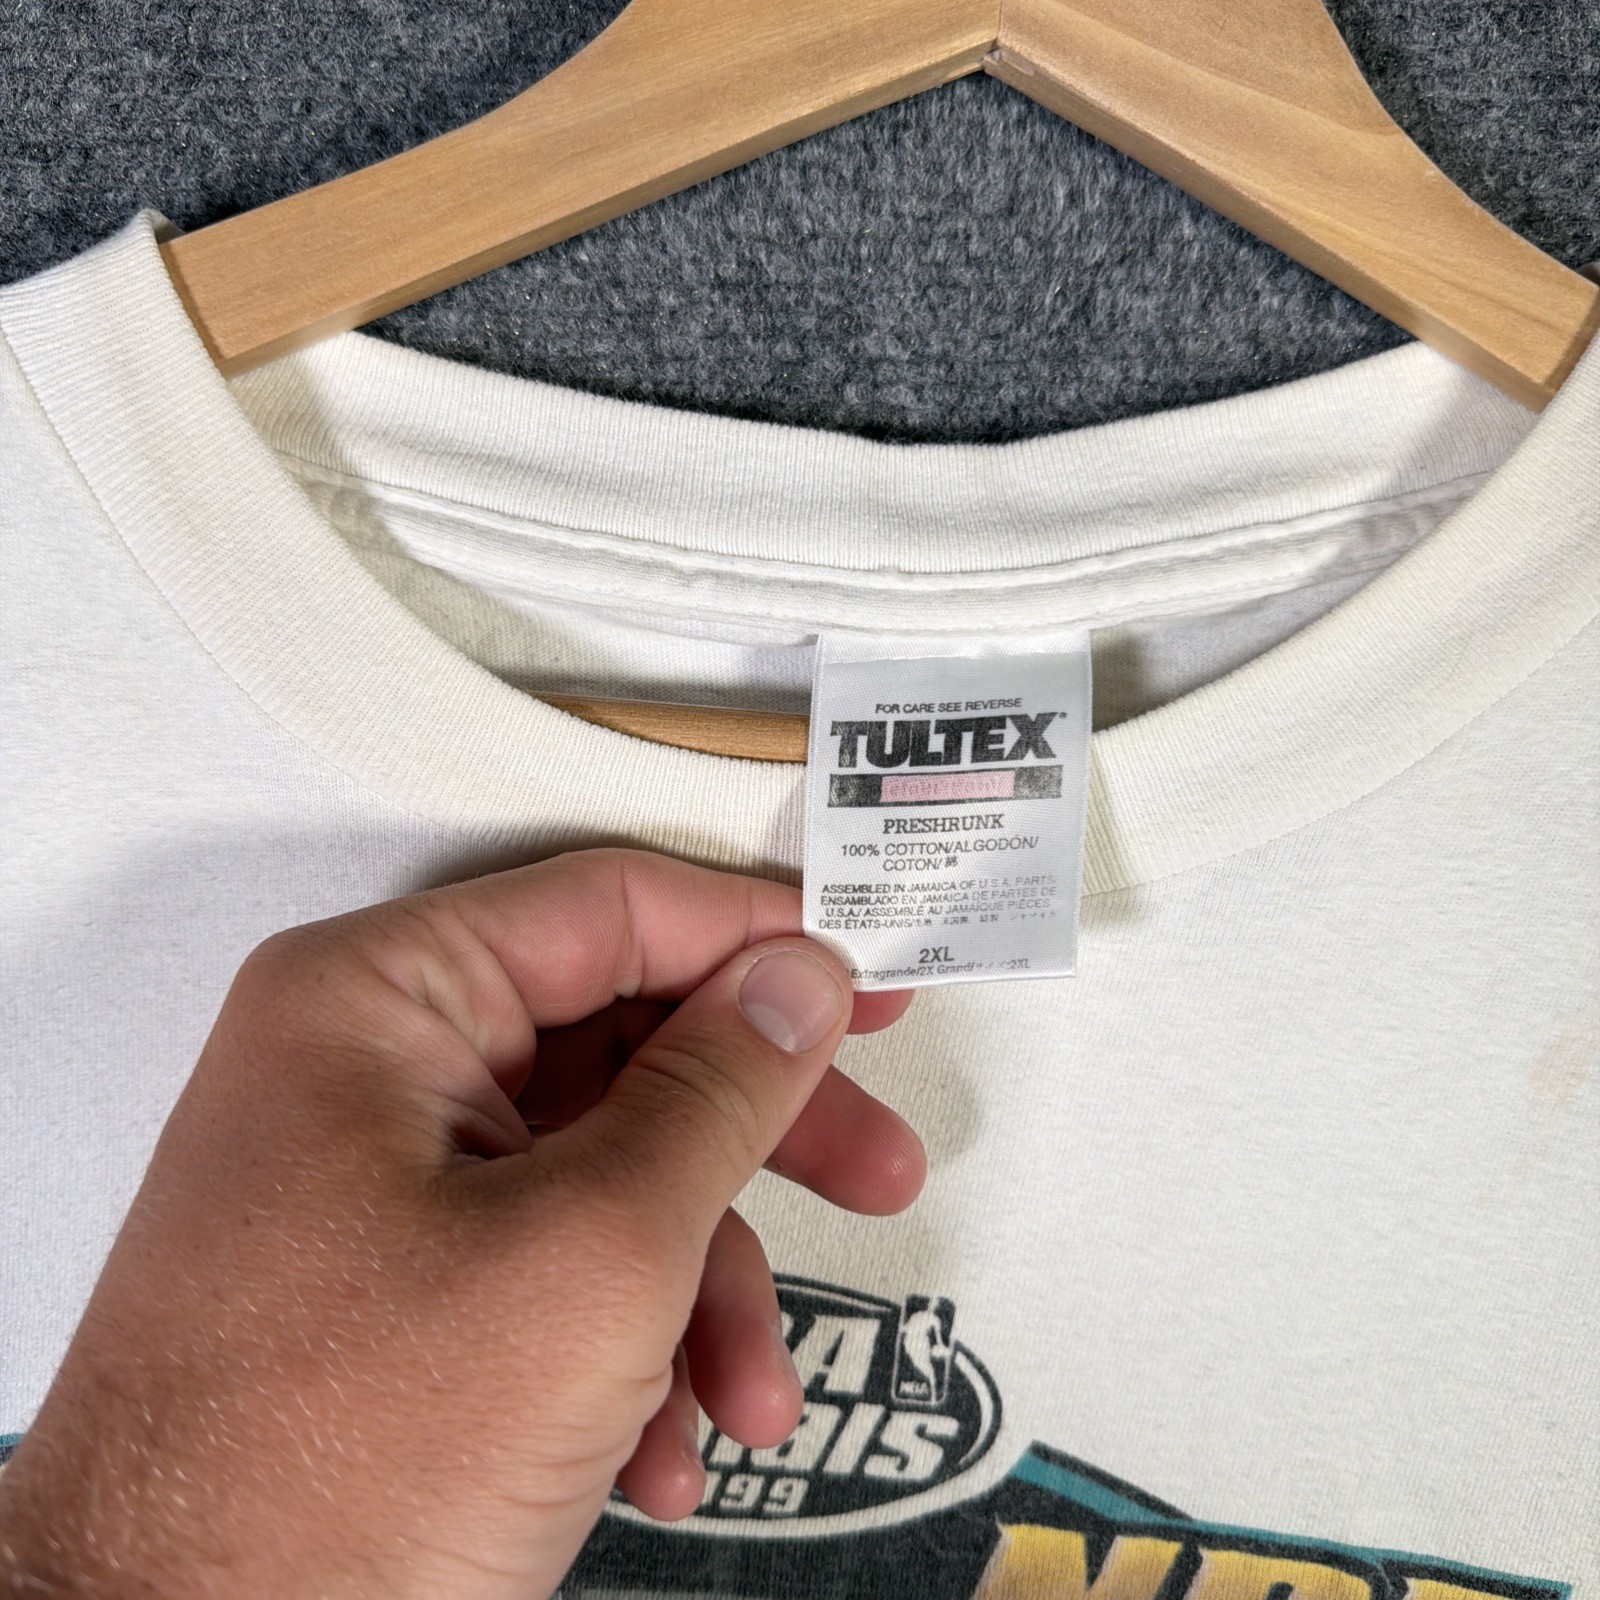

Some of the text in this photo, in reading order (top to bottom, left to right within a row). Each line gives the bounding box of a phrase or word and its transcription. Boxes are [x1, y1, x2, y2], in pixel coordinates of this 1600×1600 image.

[875, 698, 1022, 714] FOR CARE SEE REVERSE
[883, 814, 1005, 834] PRESHRUNK
[841, 843, 880, 857] 100%
[822, 883, 891, 894] ASSEMBLED
[893, 883, 905, 893] IN
[907, 881, 956, 892] JAMAICA
[960, 880, 976, 890] OF
[820, 894, 898, 905] ENSAMBLADO
[901, 895, 917, 904] EN
[920, 892, 969, 904] JAMAICA
[972, 890, 989, 900] DE
[991, 887, 1037, 899] PARTES
[927, 905, 943, 915] AU
[818, 919, 842, 929] DES
[918, 946, 955, 964] 2XL
